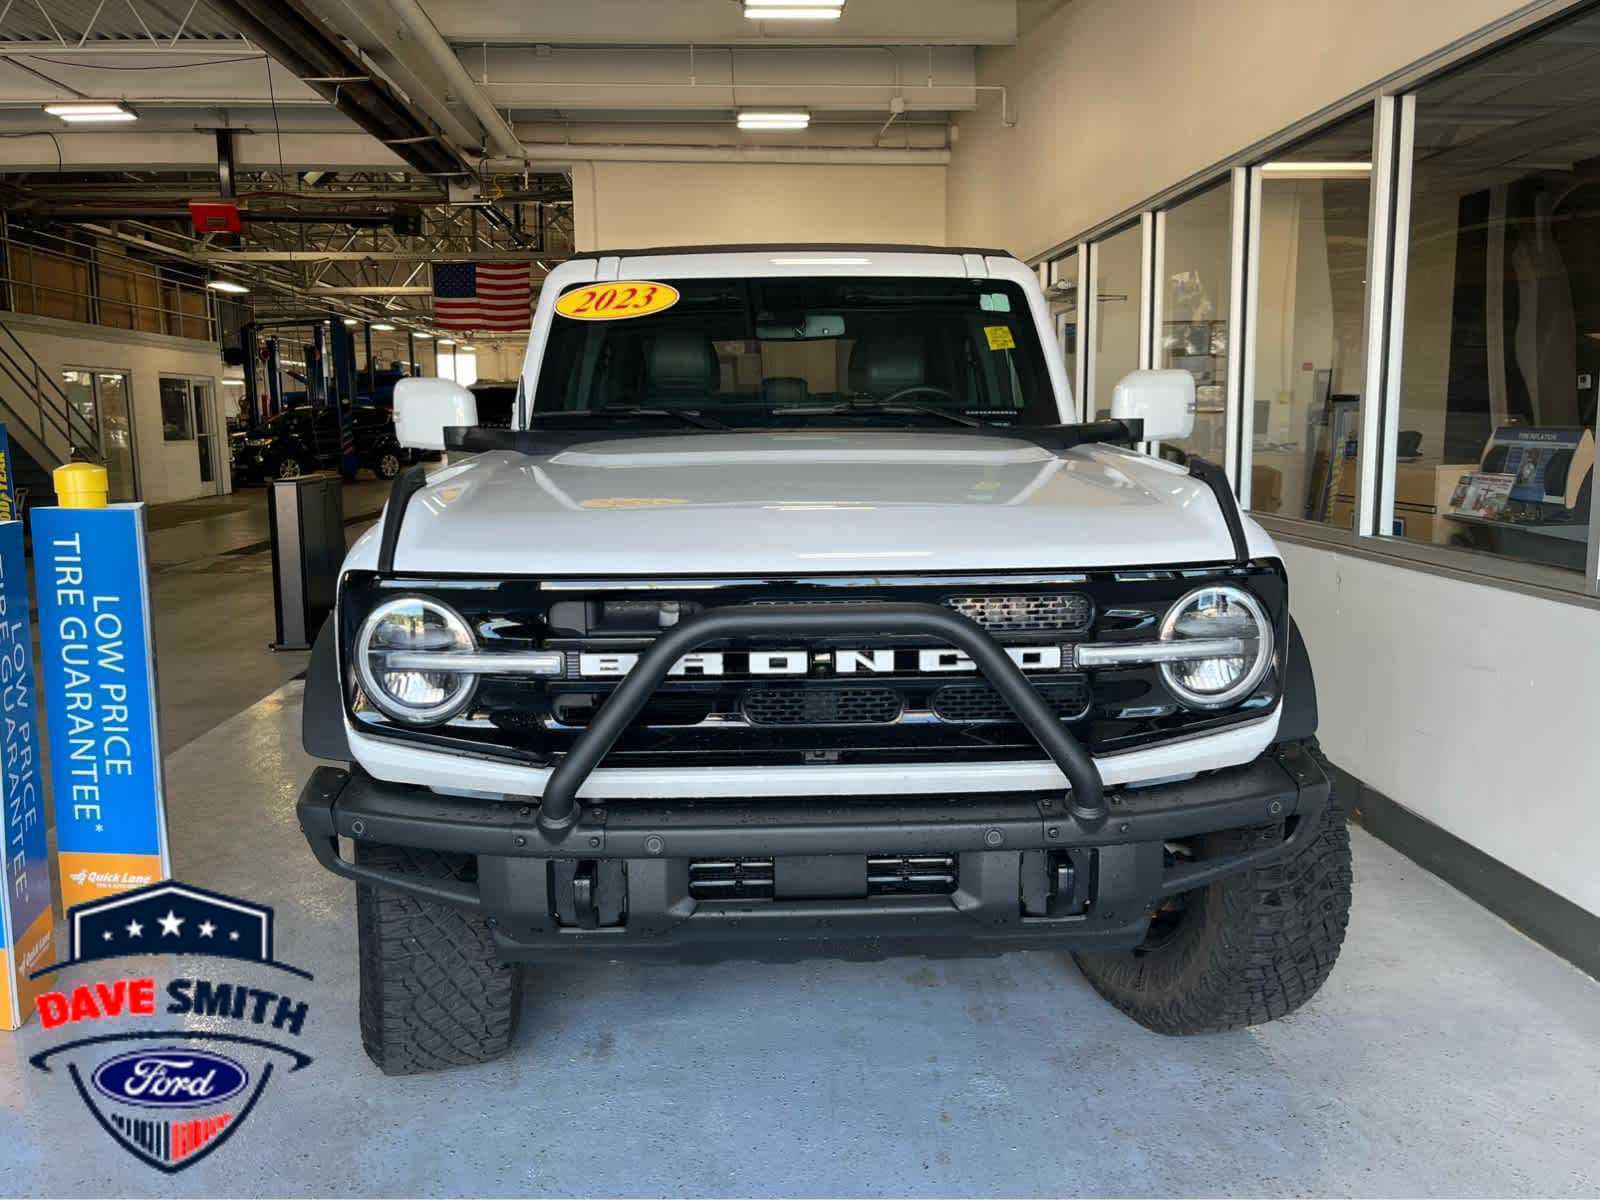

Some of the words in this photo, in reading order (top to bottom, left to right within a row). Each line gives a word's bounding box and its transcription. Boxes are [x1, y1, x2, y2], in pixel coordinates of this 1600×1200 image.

[573, 287, 658, 313] 2023
[53, 532, 86, 607] TIRE
[11, 621, 29, 708] LOW
[92, 595, 126, 673] LOW
[99, 683, 133, 776] PRICE
[18, 720, 37, 833] PRICE
[87, 871, 120, 884] Quick
[121, 872, 152, 885] Lane
